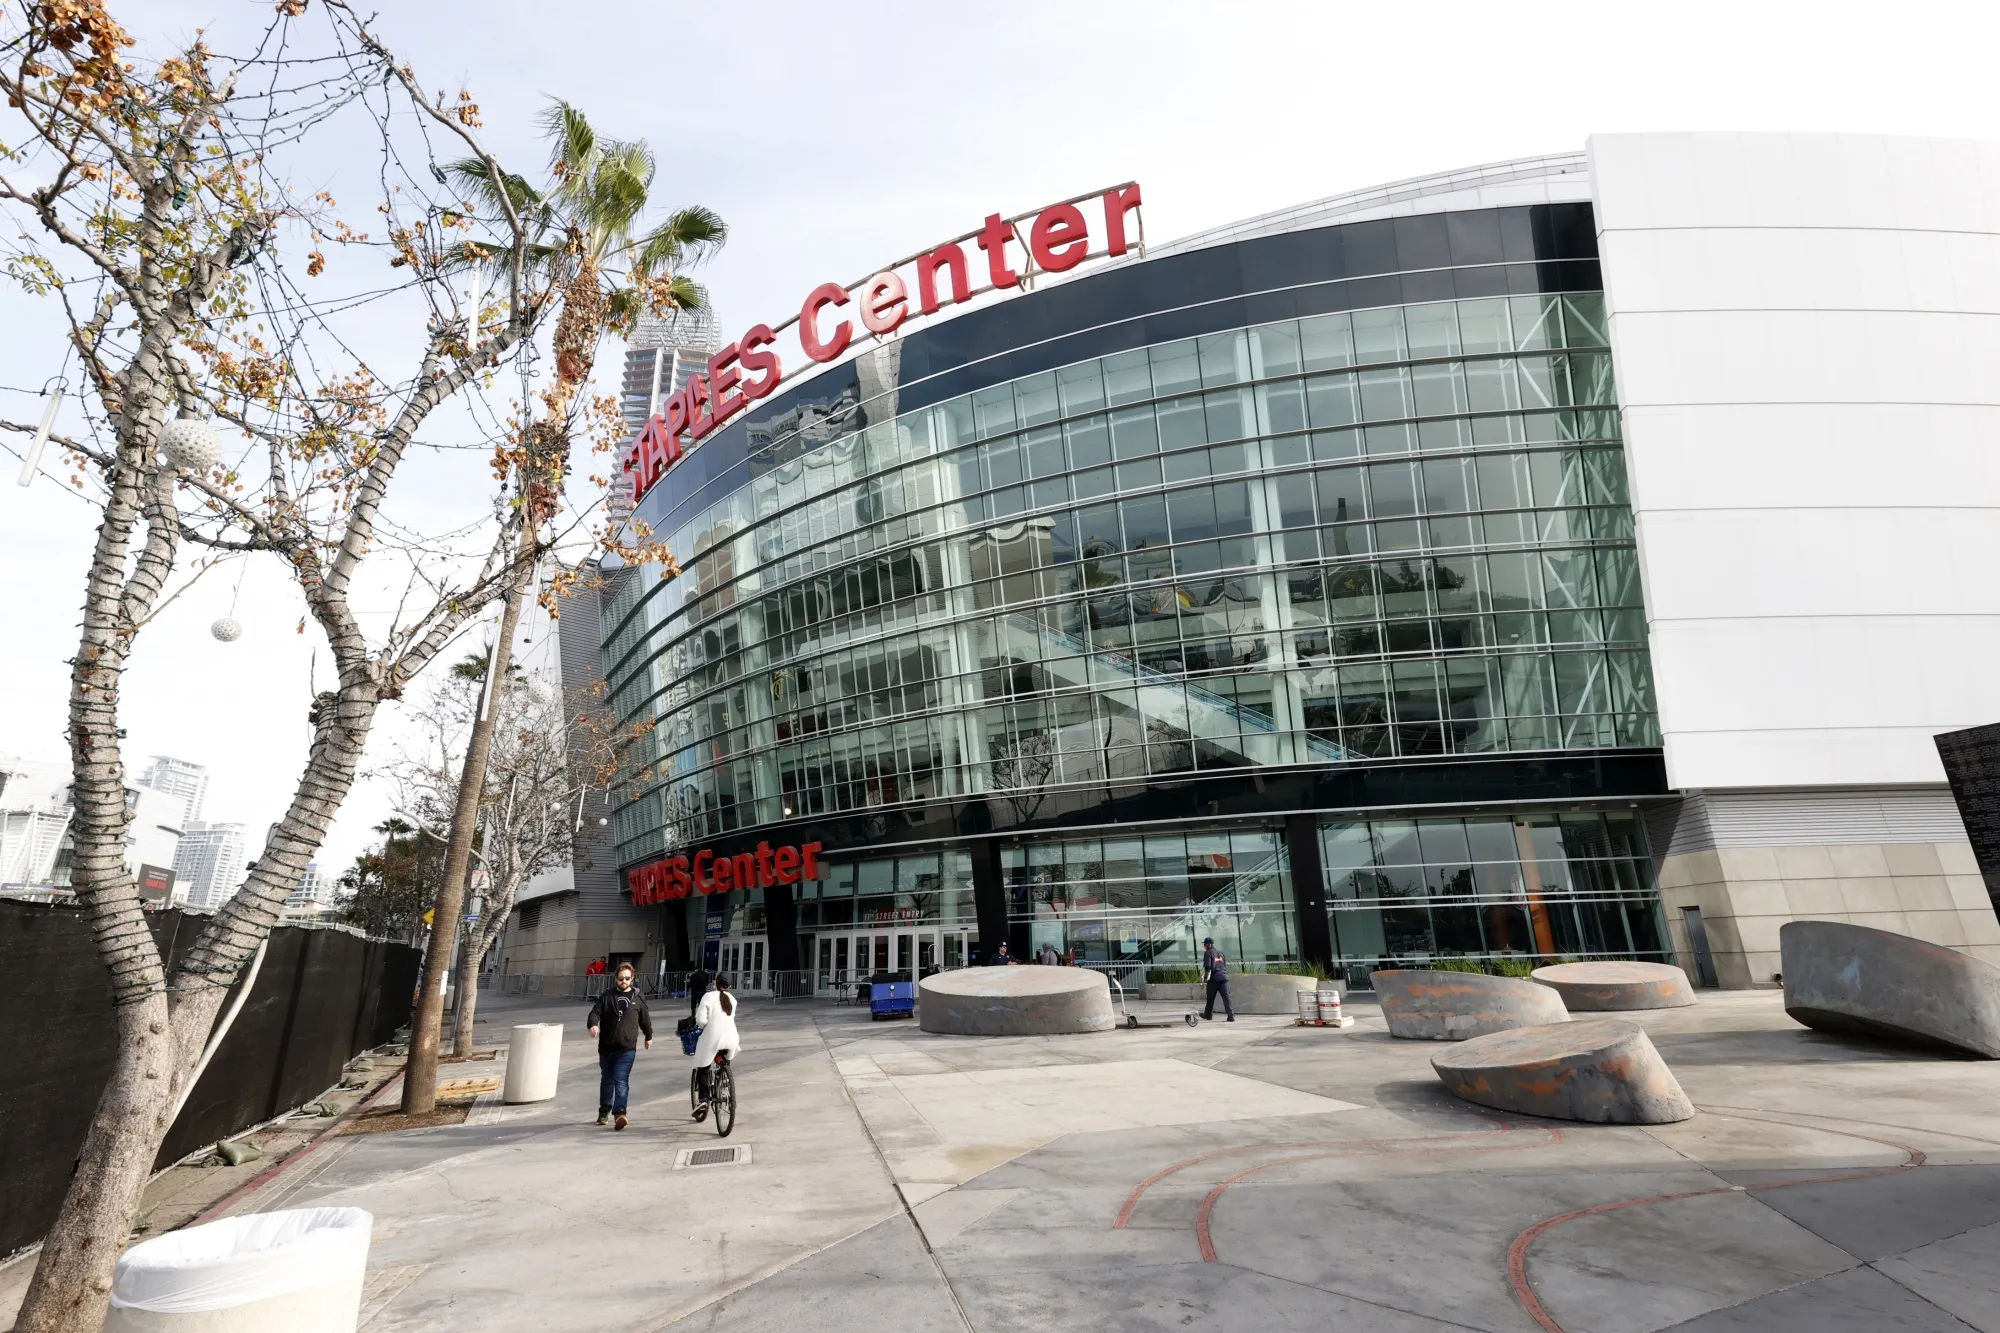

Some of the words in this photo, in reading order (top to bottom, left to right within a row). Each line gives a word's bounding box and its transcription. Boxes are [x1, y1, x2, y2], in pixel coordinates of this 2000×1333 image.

[621, 323, 782, 508] STAPLES
[798, 182, 1141, 363] Center
[629, 855, 693, 906] STAPLES
[694, 841, 822, 894] Center
[875, 911, 899, 921] STREET
[902, 910, 925, 919] ENTRY
